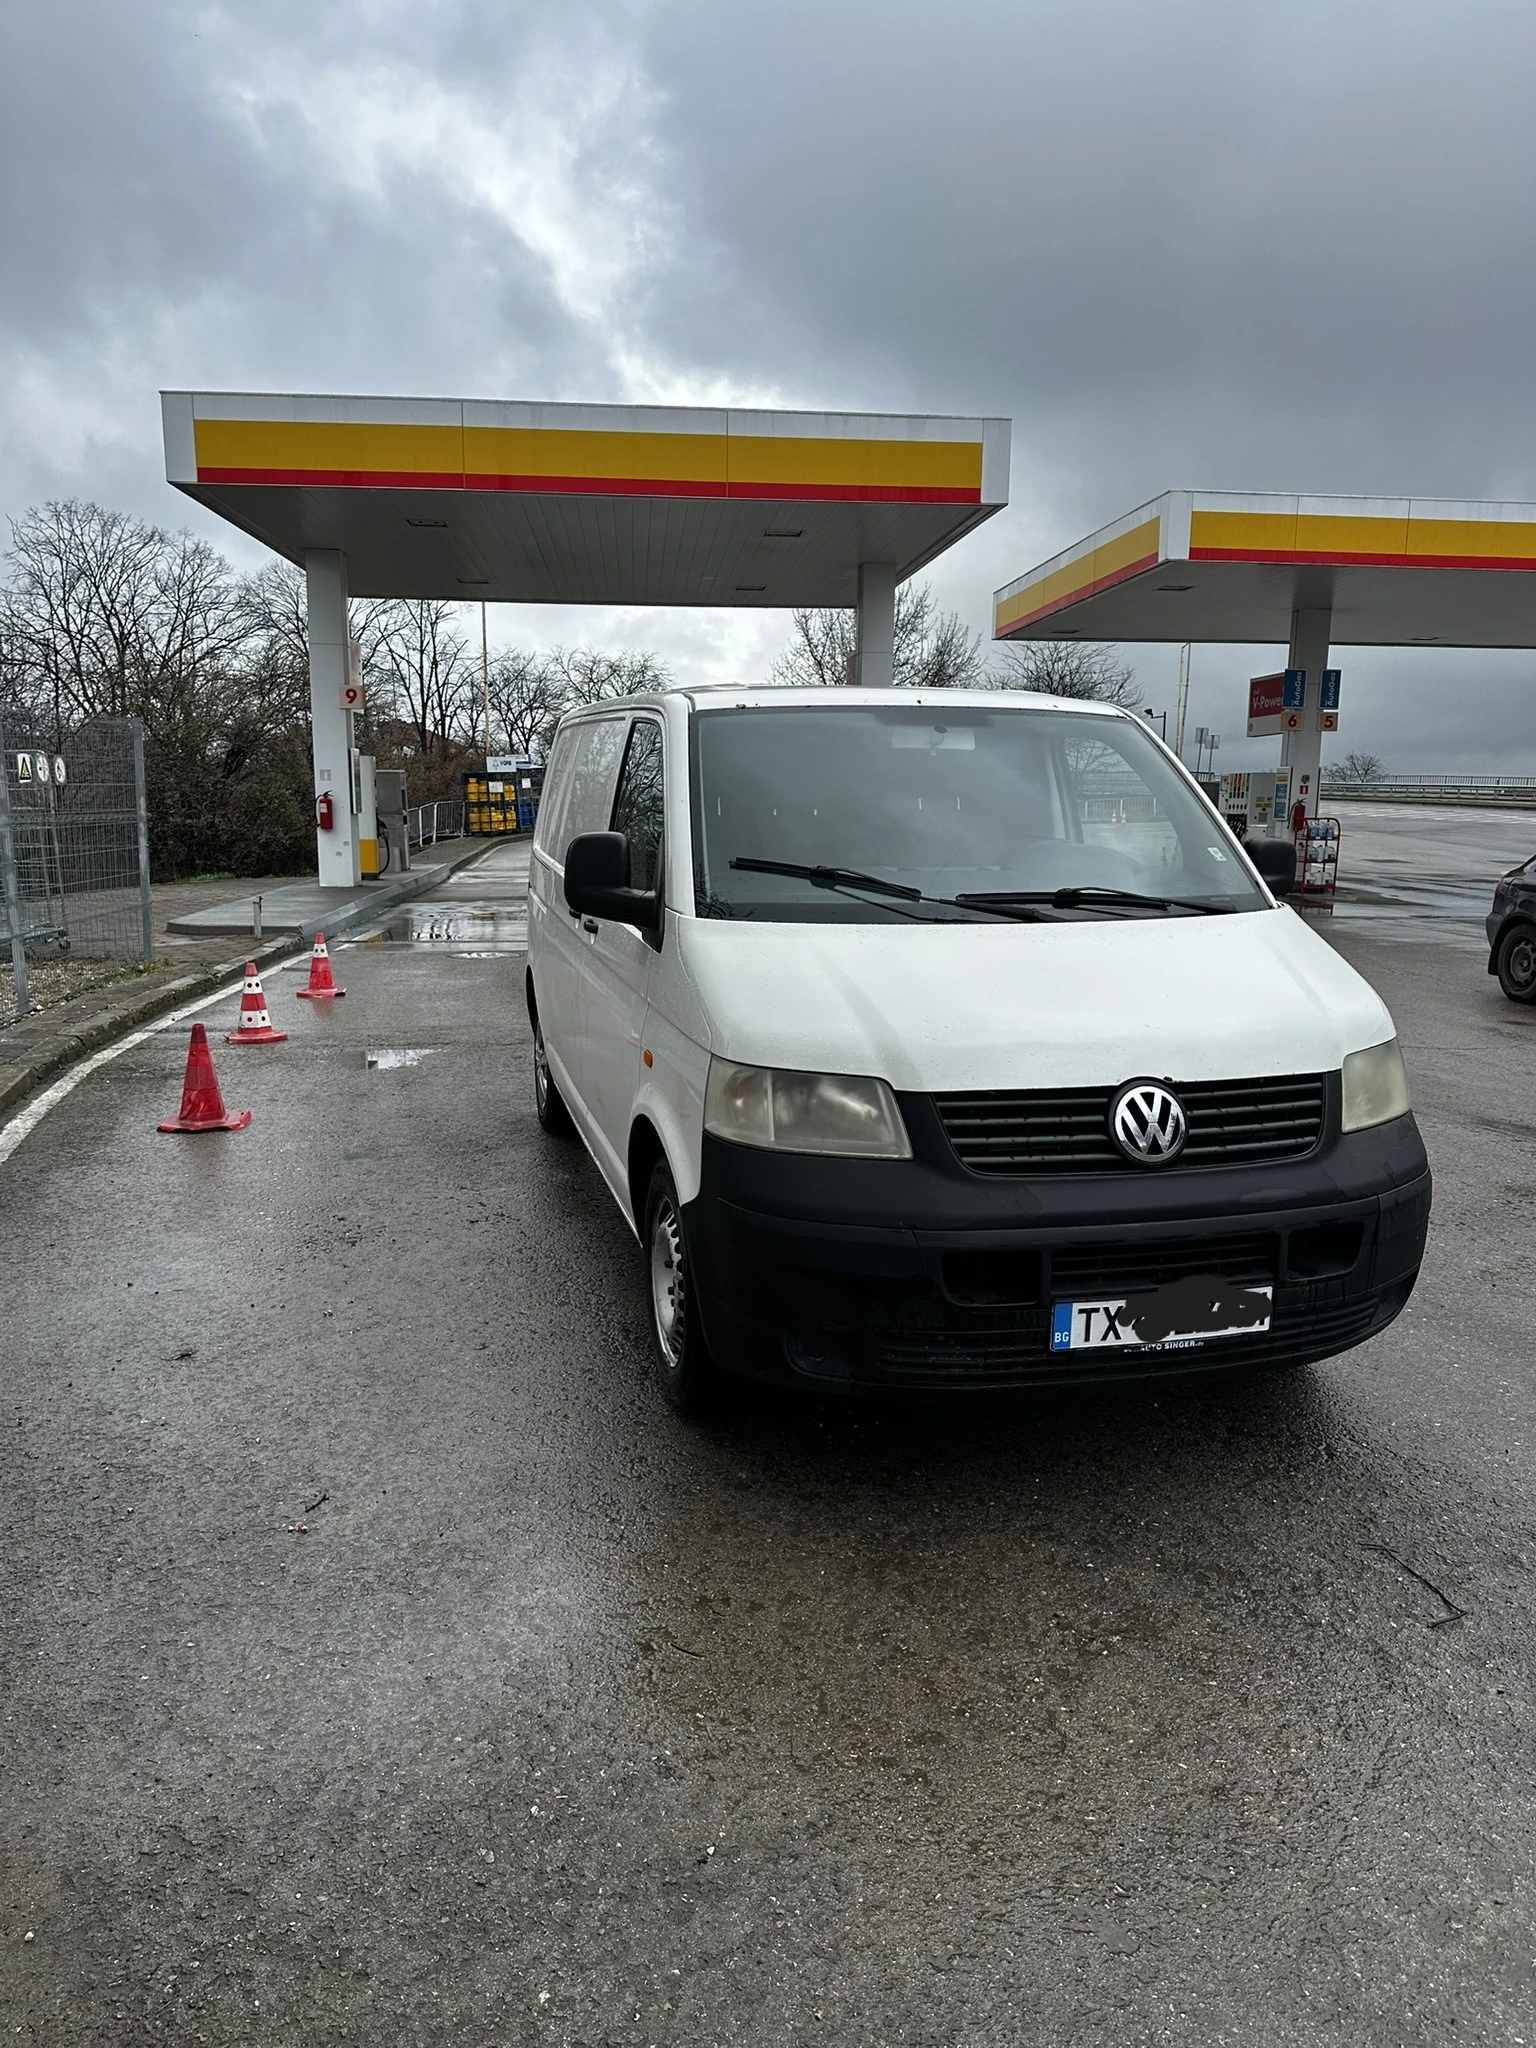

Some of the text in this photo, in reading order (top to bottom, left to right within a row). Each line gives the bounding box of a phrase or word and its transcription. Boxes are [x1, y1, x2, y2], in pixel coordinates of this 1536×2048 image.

[345, 688, 357, 704] 9
[1293, 671, 1302, 706] AutoGas
[1327, 672, 1336, 706] AutoGas
[1287, 714, 1297, 728] 6
[1324, 715, 1334, 728] 5
[1115, 1086, 1185, 1162] VW
[1054, 1332, 1069, 1343] BG
